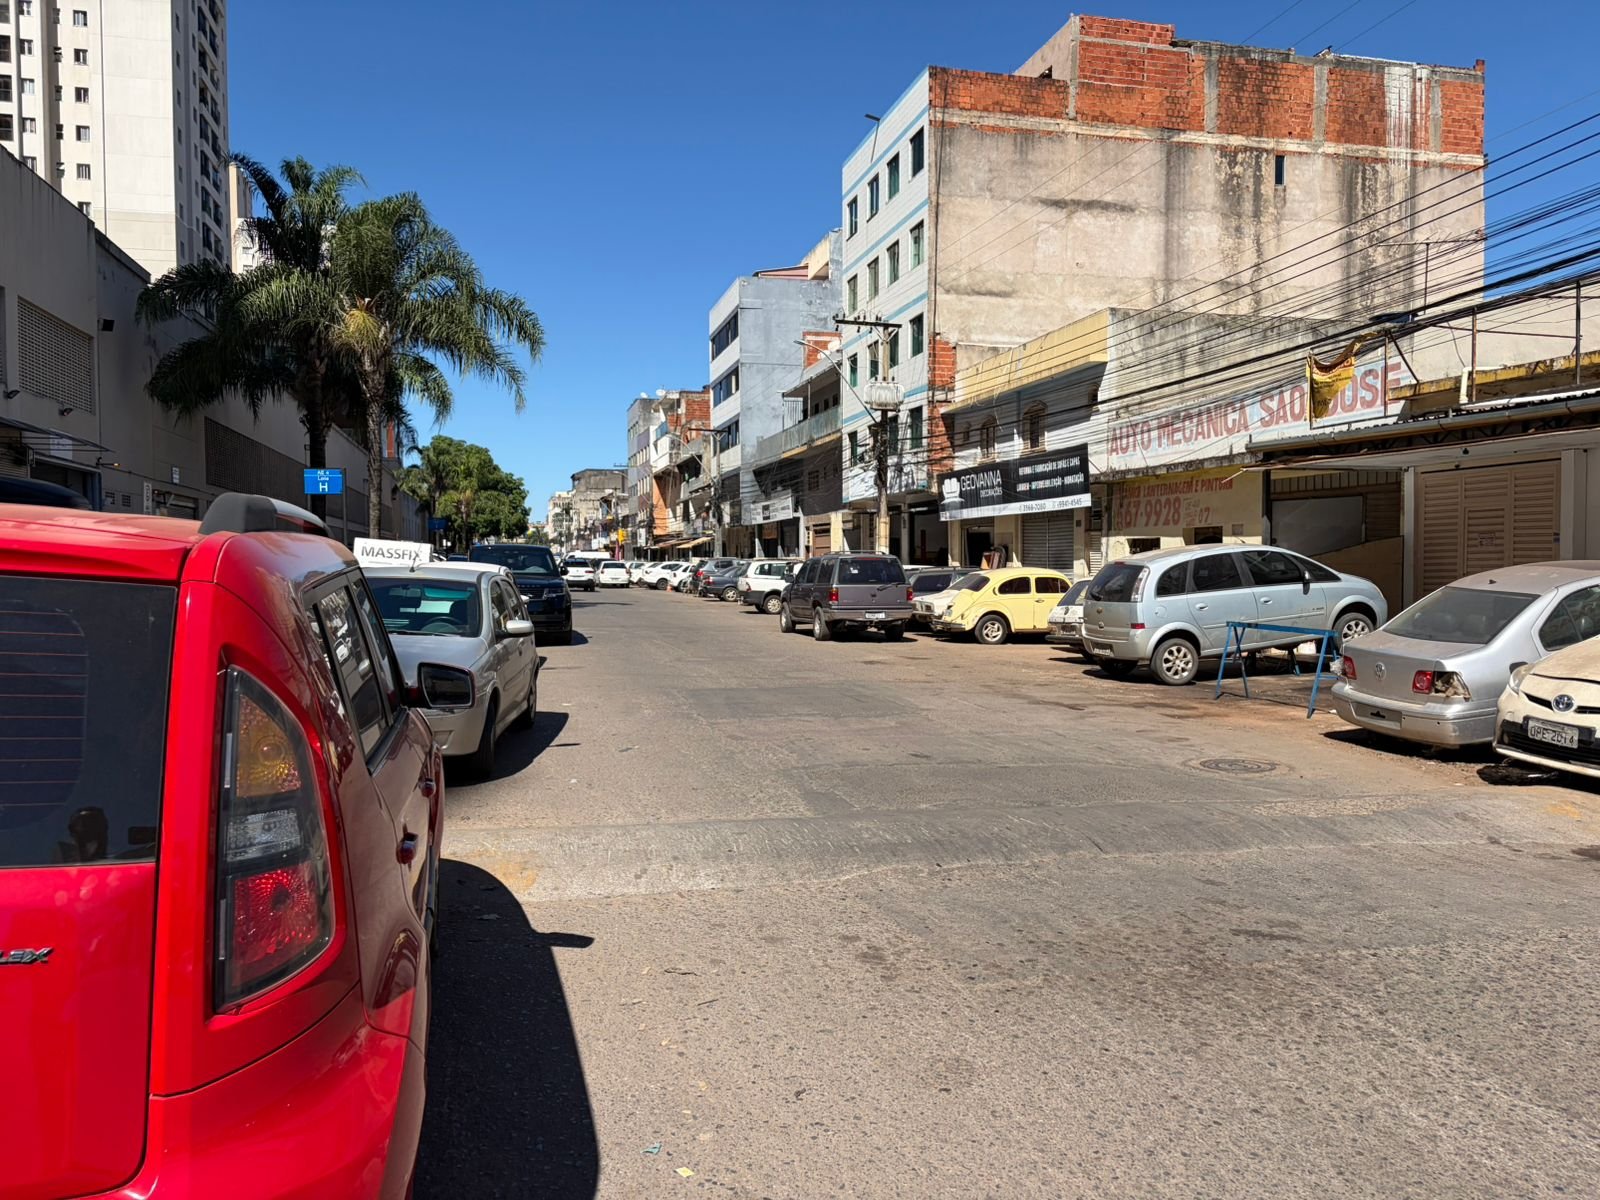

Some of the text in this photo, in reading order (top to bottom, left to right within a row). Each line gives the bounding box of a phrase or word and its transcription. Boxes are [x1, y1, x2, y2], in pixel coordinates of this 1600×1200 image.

[1109, 420, 1153, 457] AUTO
[319, 482, 328, 492] H
[960, 469, 1002, 491] GEOVANNA
[361, 546, 420, 561] MASSFIX
